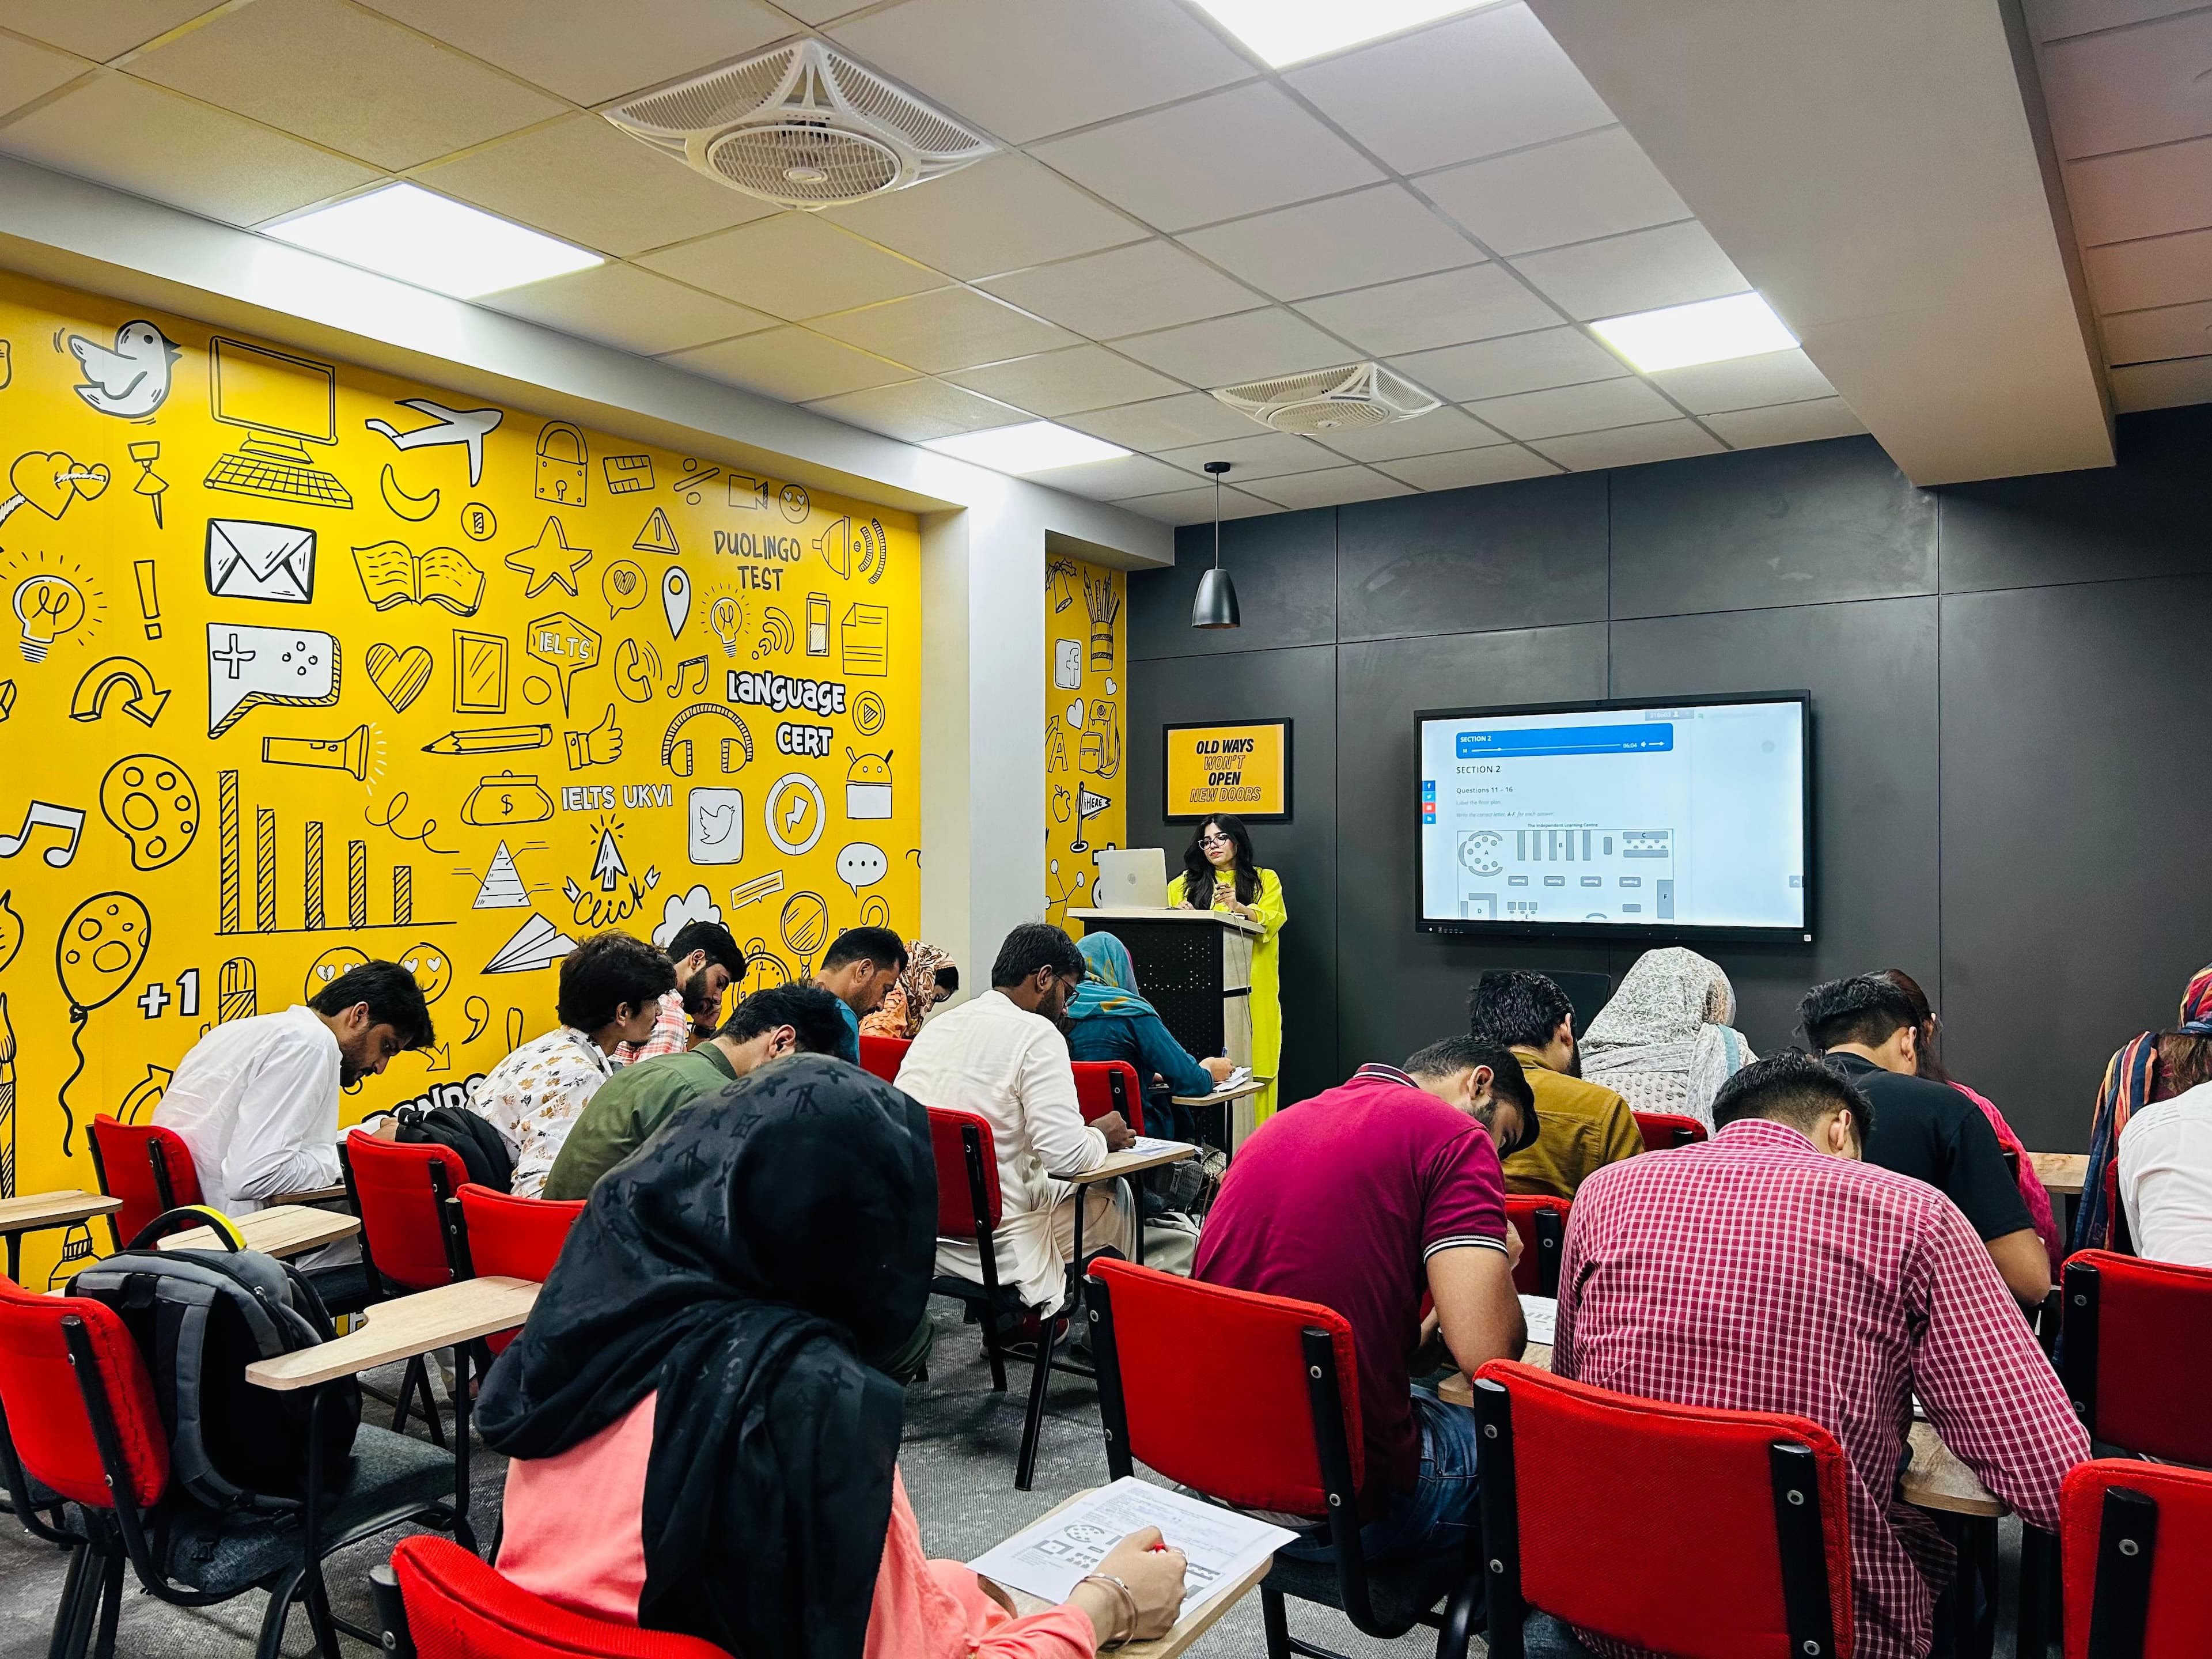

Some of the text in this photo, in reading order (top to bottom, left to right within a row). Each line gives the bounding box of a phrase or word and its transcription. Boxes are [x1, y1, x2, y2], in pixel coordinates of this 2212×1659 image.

[714, 531, 801, 562] DUOLINGO
[737, 566, 784, 591] TEST
[539, 631, 590, 659] IELTS
[776, 722, 833, 759] CERT
[1048, 733, 1068, 772] A
[1196, 738, 1254, 755] OLD WAYS
[1204, 755, 1245, 770] WON'T
[1209, 772, 1241, 786] OPEN
[561, 783, 673, 811] IELTS UKVI
[1190, 787, 1261, 802] NEW DOORS
[574, 876, 645, 929] Click
[137, 968, 199, 1020] +1
